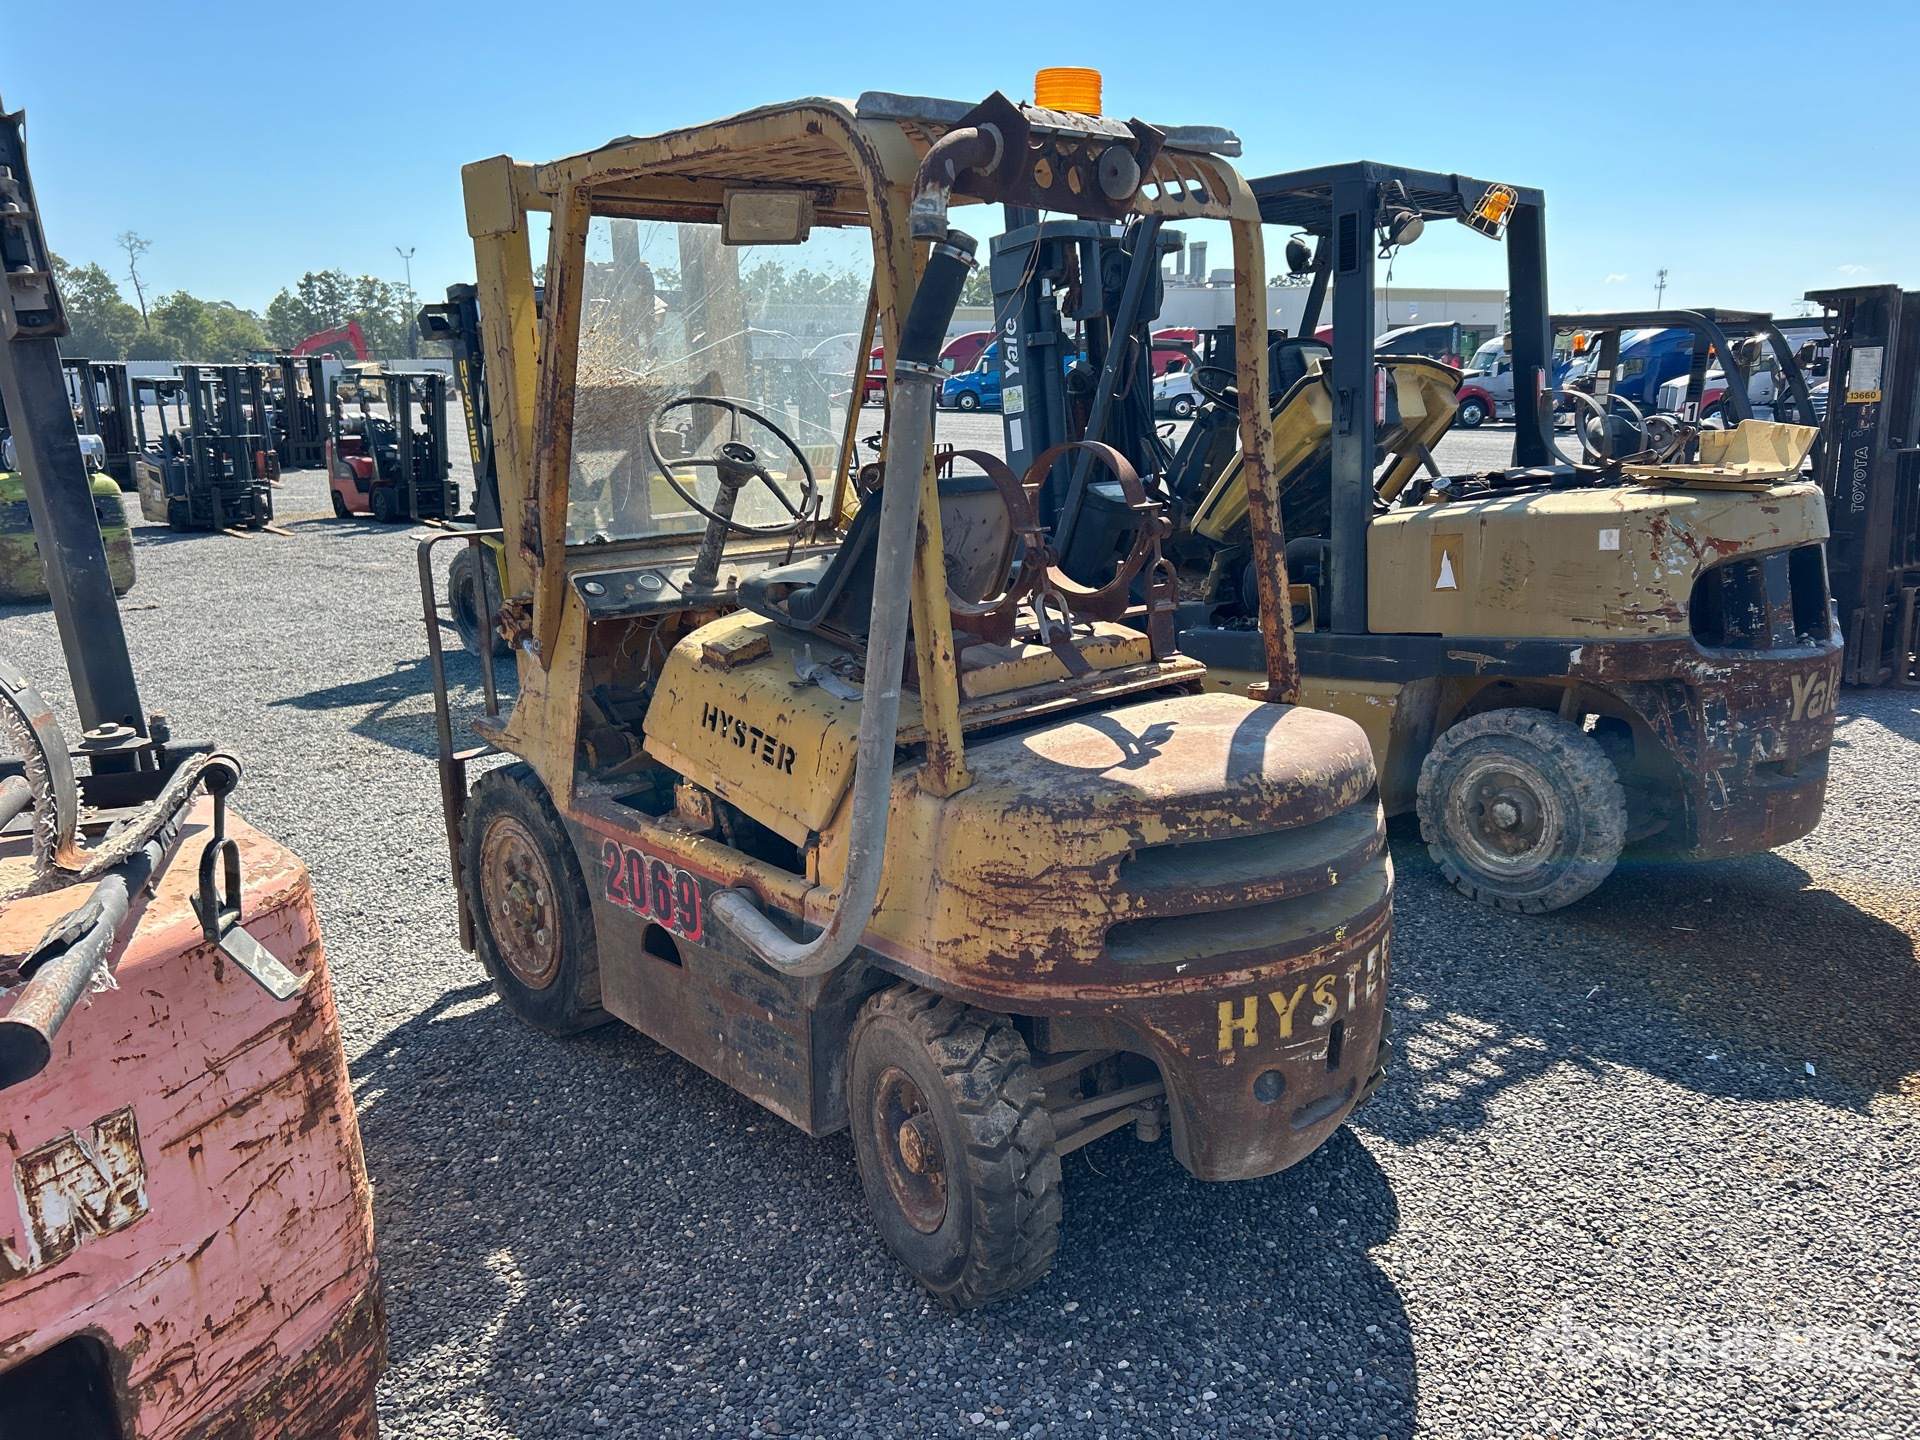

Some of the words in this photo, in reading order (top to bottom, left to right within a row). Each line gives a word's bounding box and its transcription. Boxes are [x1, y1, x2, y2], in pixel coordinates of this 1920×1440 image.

[1003, 317, 1020, 379] Yale
[459, 359, 481, 464] HYSTER
[1687, 403, 1696, 421] 1
[1850, 391, 1876, 400] 13660
[1851, 446, 1868, 514] TOYOTA
[701, 702, 796, 776] HYSTER
[603, 838, 702, 942] 2069
